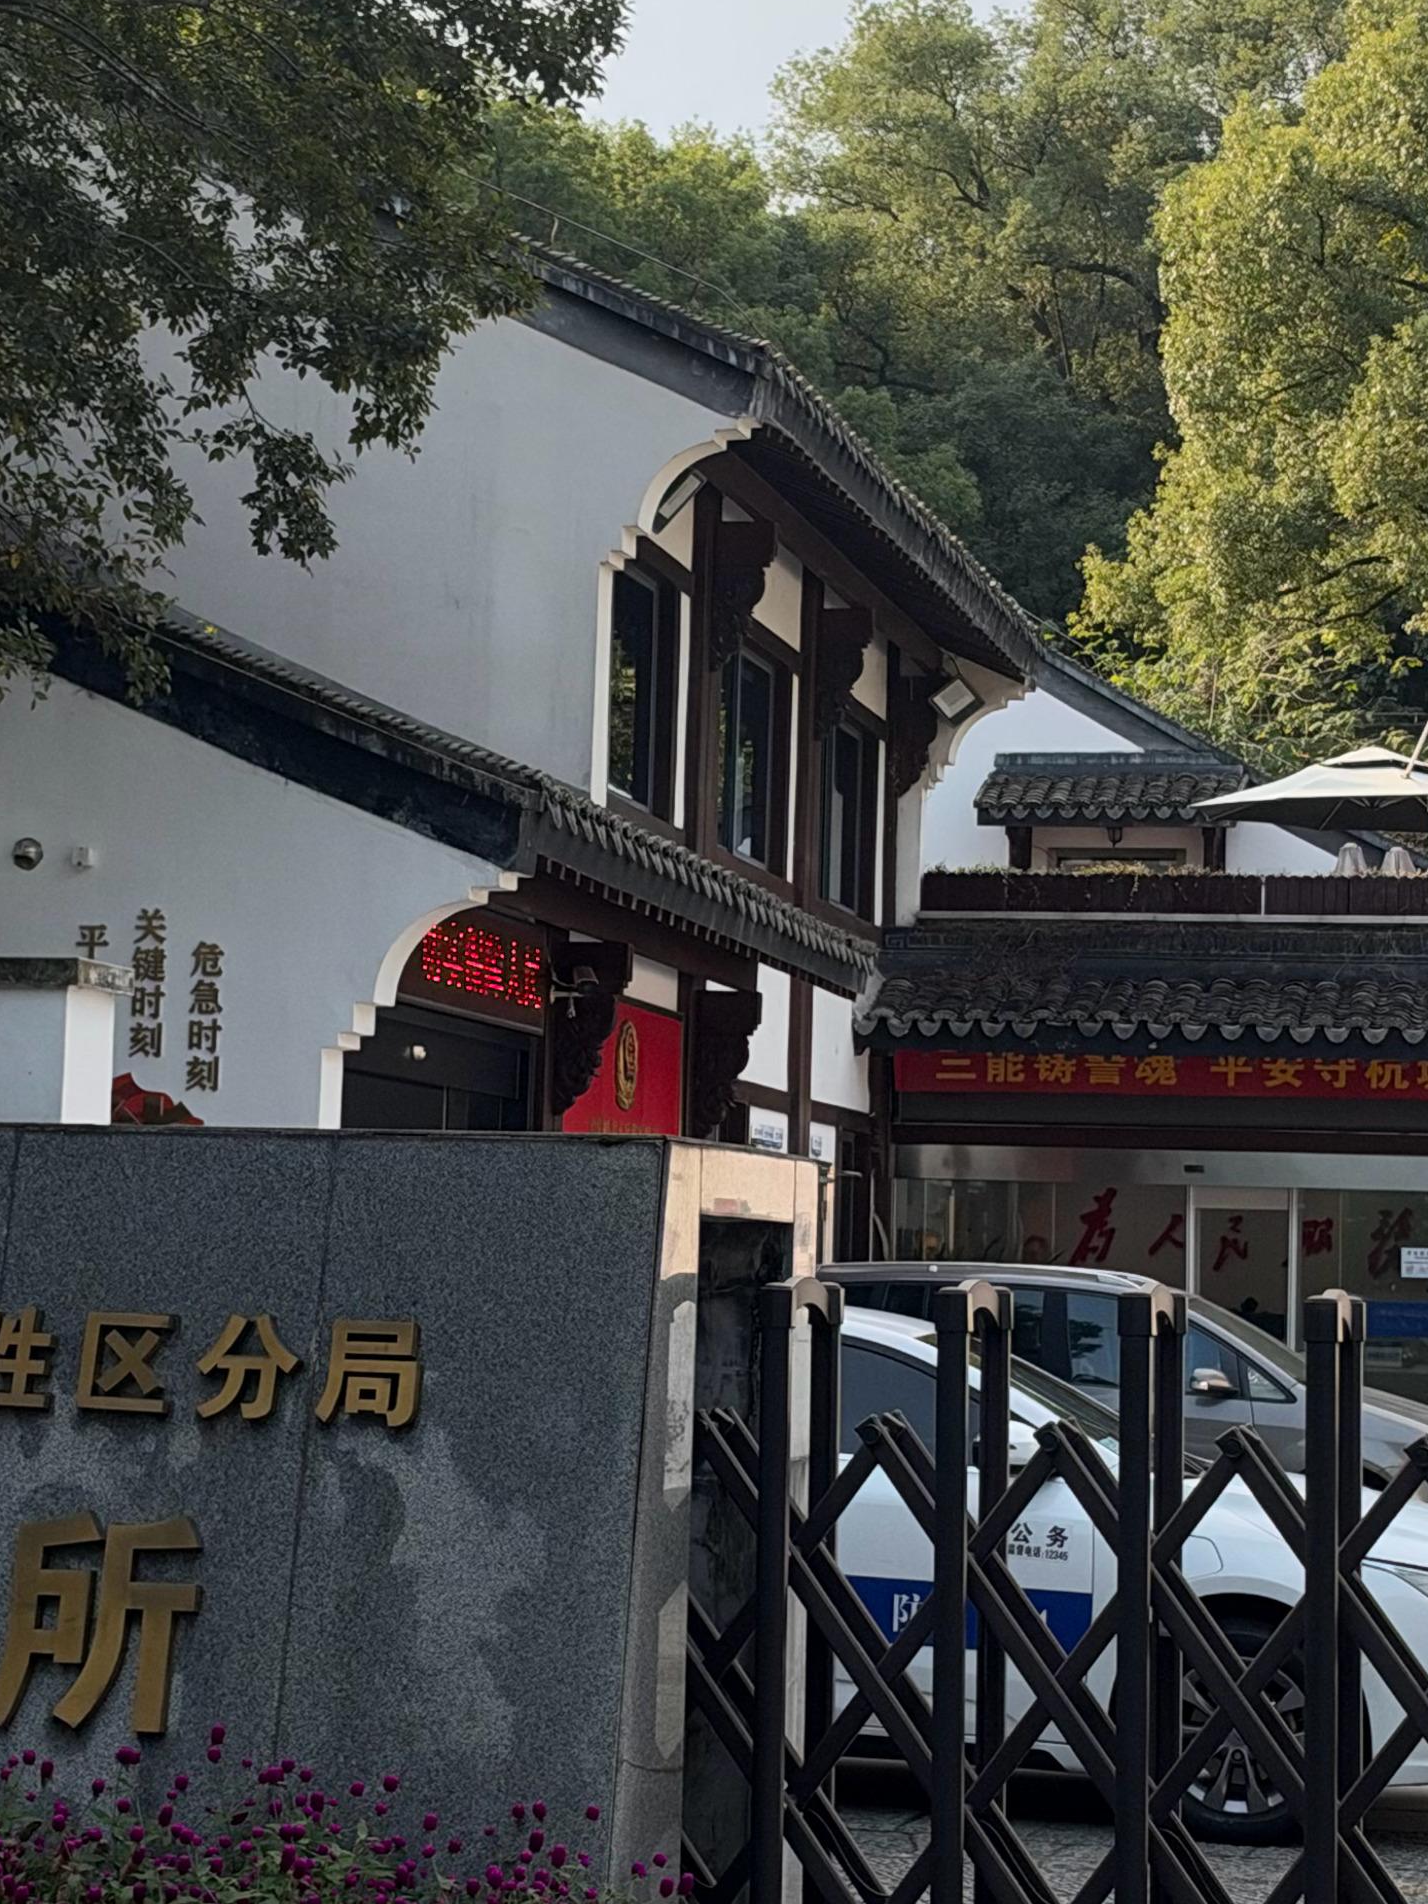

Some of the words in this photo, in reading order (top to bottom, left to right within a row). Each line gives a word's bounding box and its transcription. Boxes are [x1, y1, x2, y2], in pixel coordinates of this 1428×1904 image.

[127, 907, 168, 1060] 关键时刻
[184, 940, 226, 1093] 危急时刻
[1010, 1522, 1069, 1549] 公务
